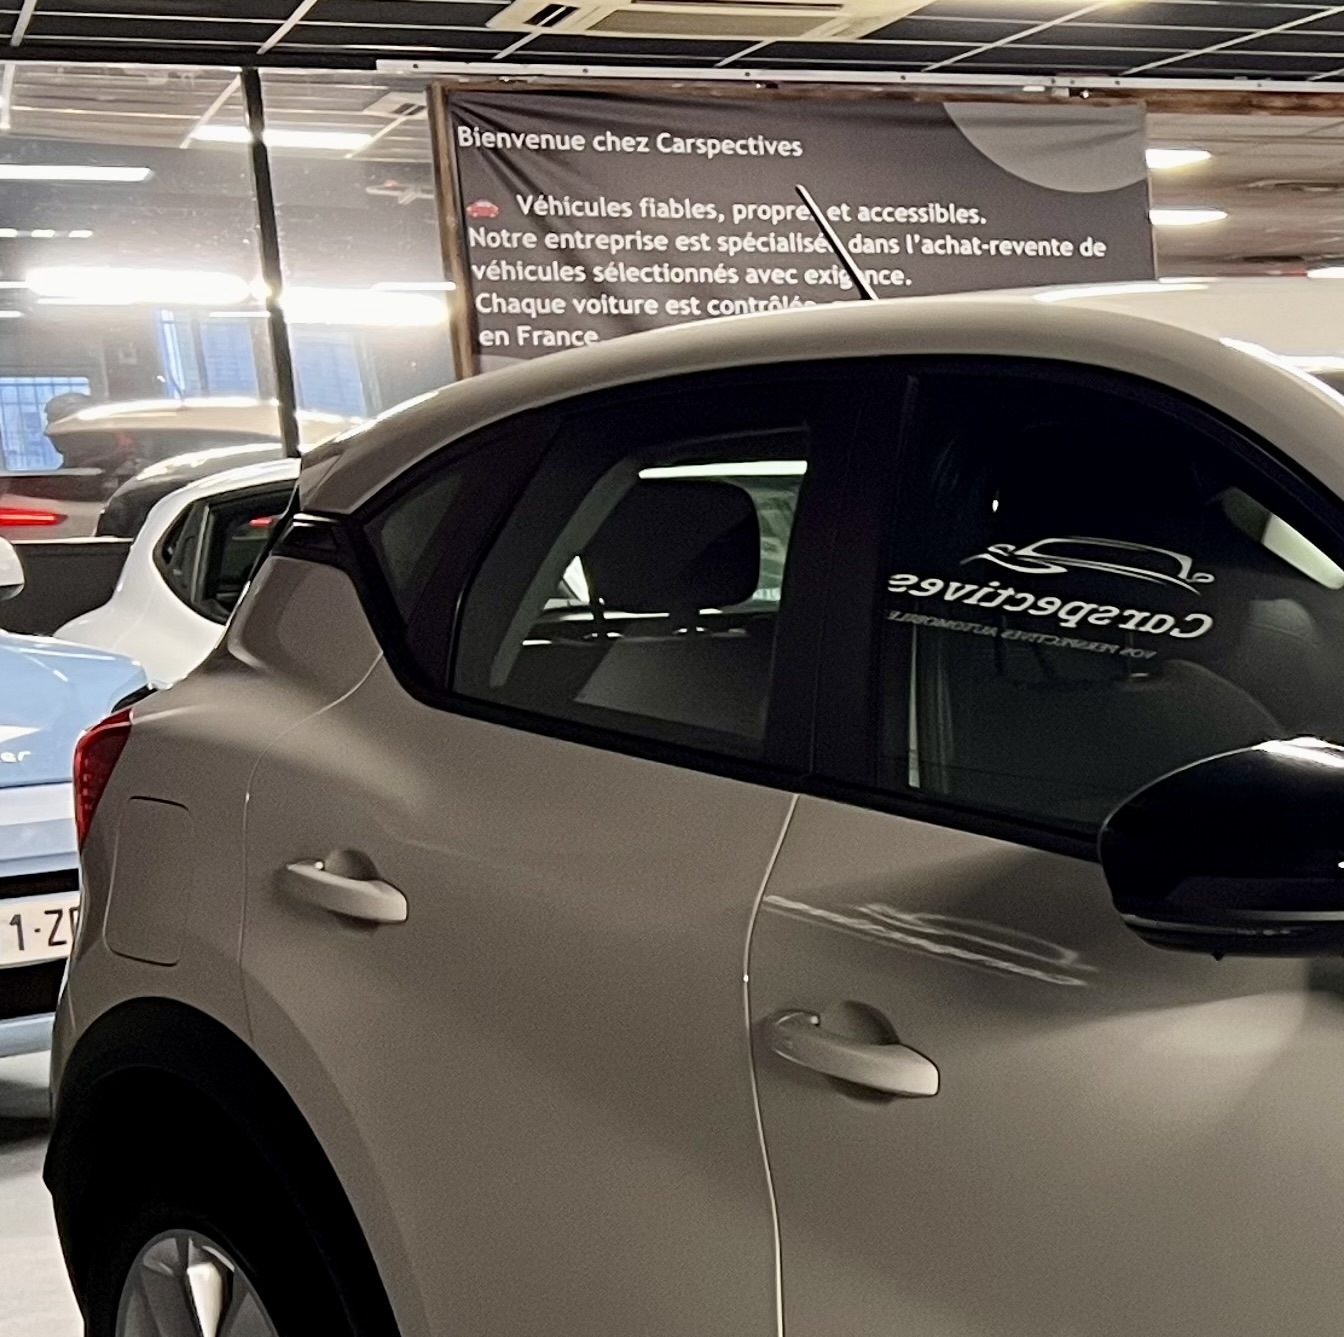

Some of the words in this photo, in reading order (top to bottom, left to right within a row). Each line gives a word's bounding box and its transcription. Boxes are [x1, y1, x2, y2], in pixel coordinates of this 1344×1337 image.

[457, 125, 586, 151] Bienvenue
[592, 130, 650, 153] chez
[656, 132, 803, 159] Carspectives
[516, 194, 633, 218] Véhicules
[639, 197, 725, 223] fiables,
[732, 203, 815, 225] propre
[826, 203, 852, 222] et
[857, 202, 987, 225] accessibles.
[468, 226, 538, 249] Notre
[544, 230, 669, 255] entreprise
[675, 233, 711, 252] est
[848, 233, 901, 254] dans
[1079, 236, 1107, 257] de
[471, 259, 587, 282] véhicules
[592, 261, 739, 284] sélectionnés
[745, 267, 798, 285] avec
[804, 264, 912, 290] exignce.
[475, 292, 566, 318] Chaque
[572, 293, 658, 315] voiture
[665, 296, 701, 315] est
[479, 329, 509, 346] en
[516, 325, 599, 346] France
